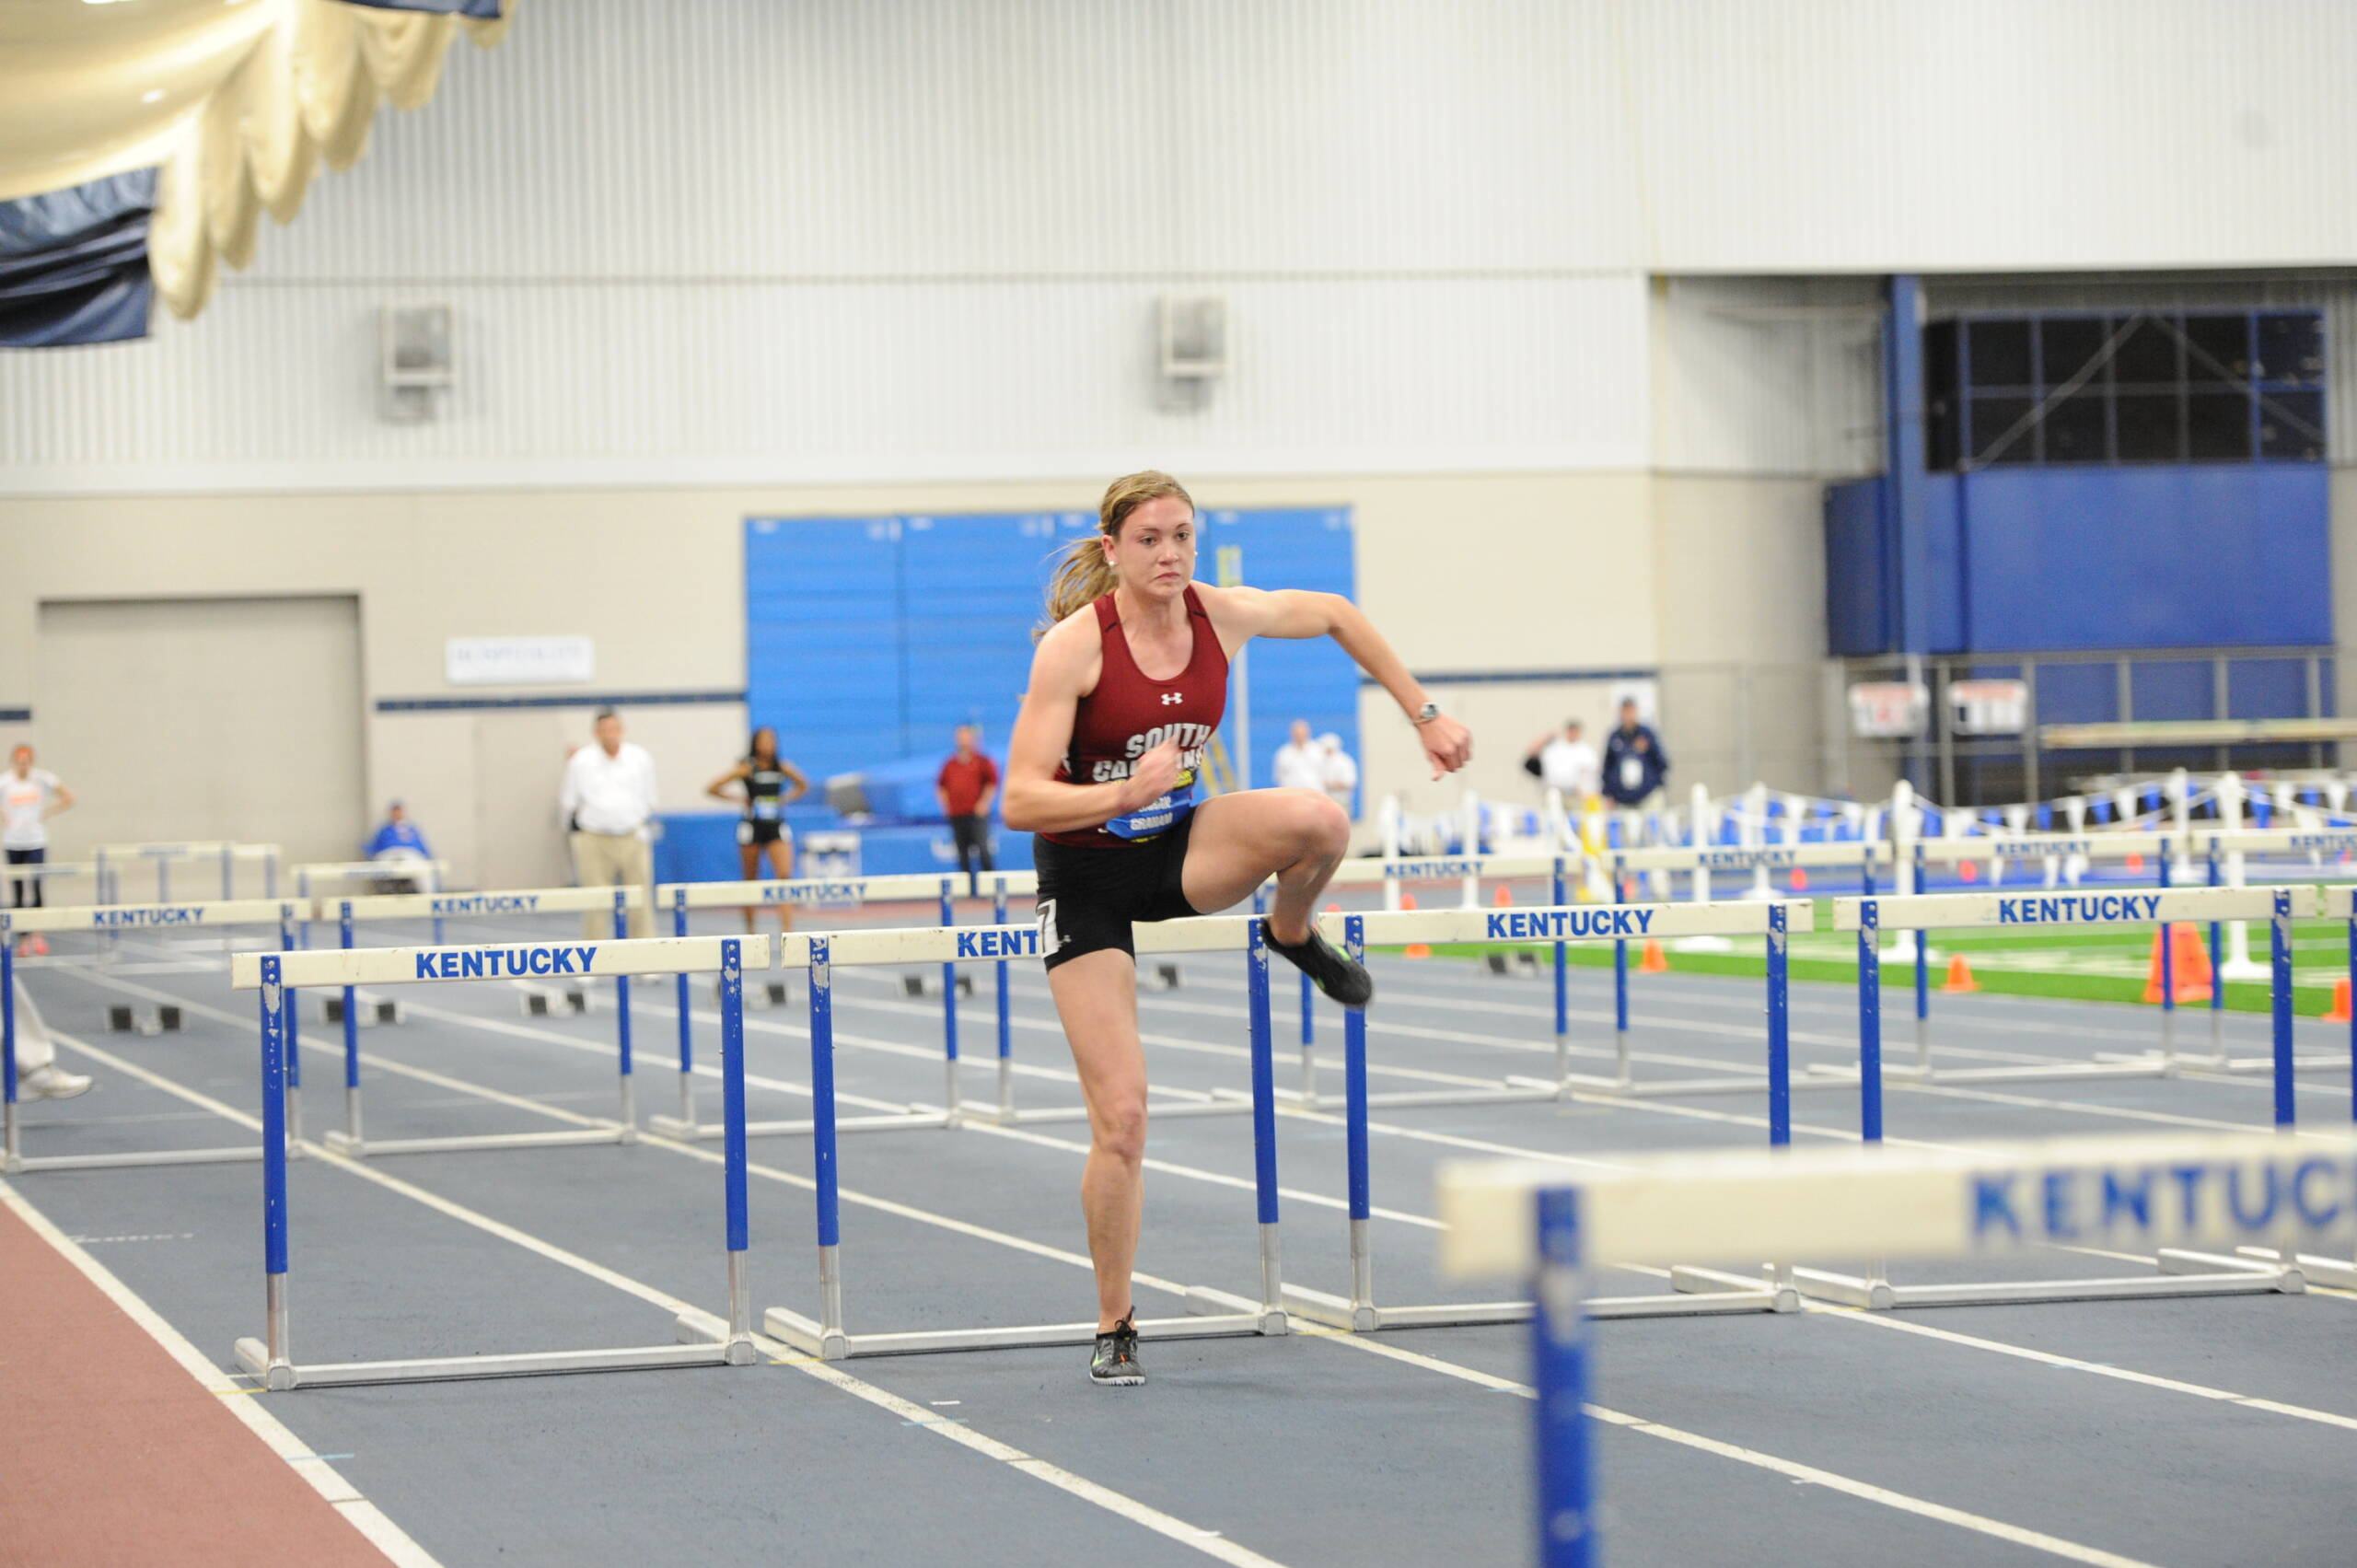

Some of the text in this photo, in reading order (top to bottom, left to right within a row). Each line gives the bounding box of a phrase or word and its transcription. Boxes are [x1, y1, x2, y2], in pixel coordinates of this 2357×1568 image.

[1124, 723, 1211, 758] SOUTH
[1385, 861, 1483, 878] KENTUCKY
[1699, 850, 1795, 866] KENTUCKY
[431, 895, 538, 913] KENTUCKY
[762, 883, 867, 902] KENTUCKY
[94, 907, 203, 926] KENTUCKY
[2000, 895, 2161, 923] KENTUCKY
[1487, 910, 1654, 937] KENTUCKY
[416, 947, 597, 979] KENTUCKY
[1970, 1157, 2357, 1236] KENTUC
